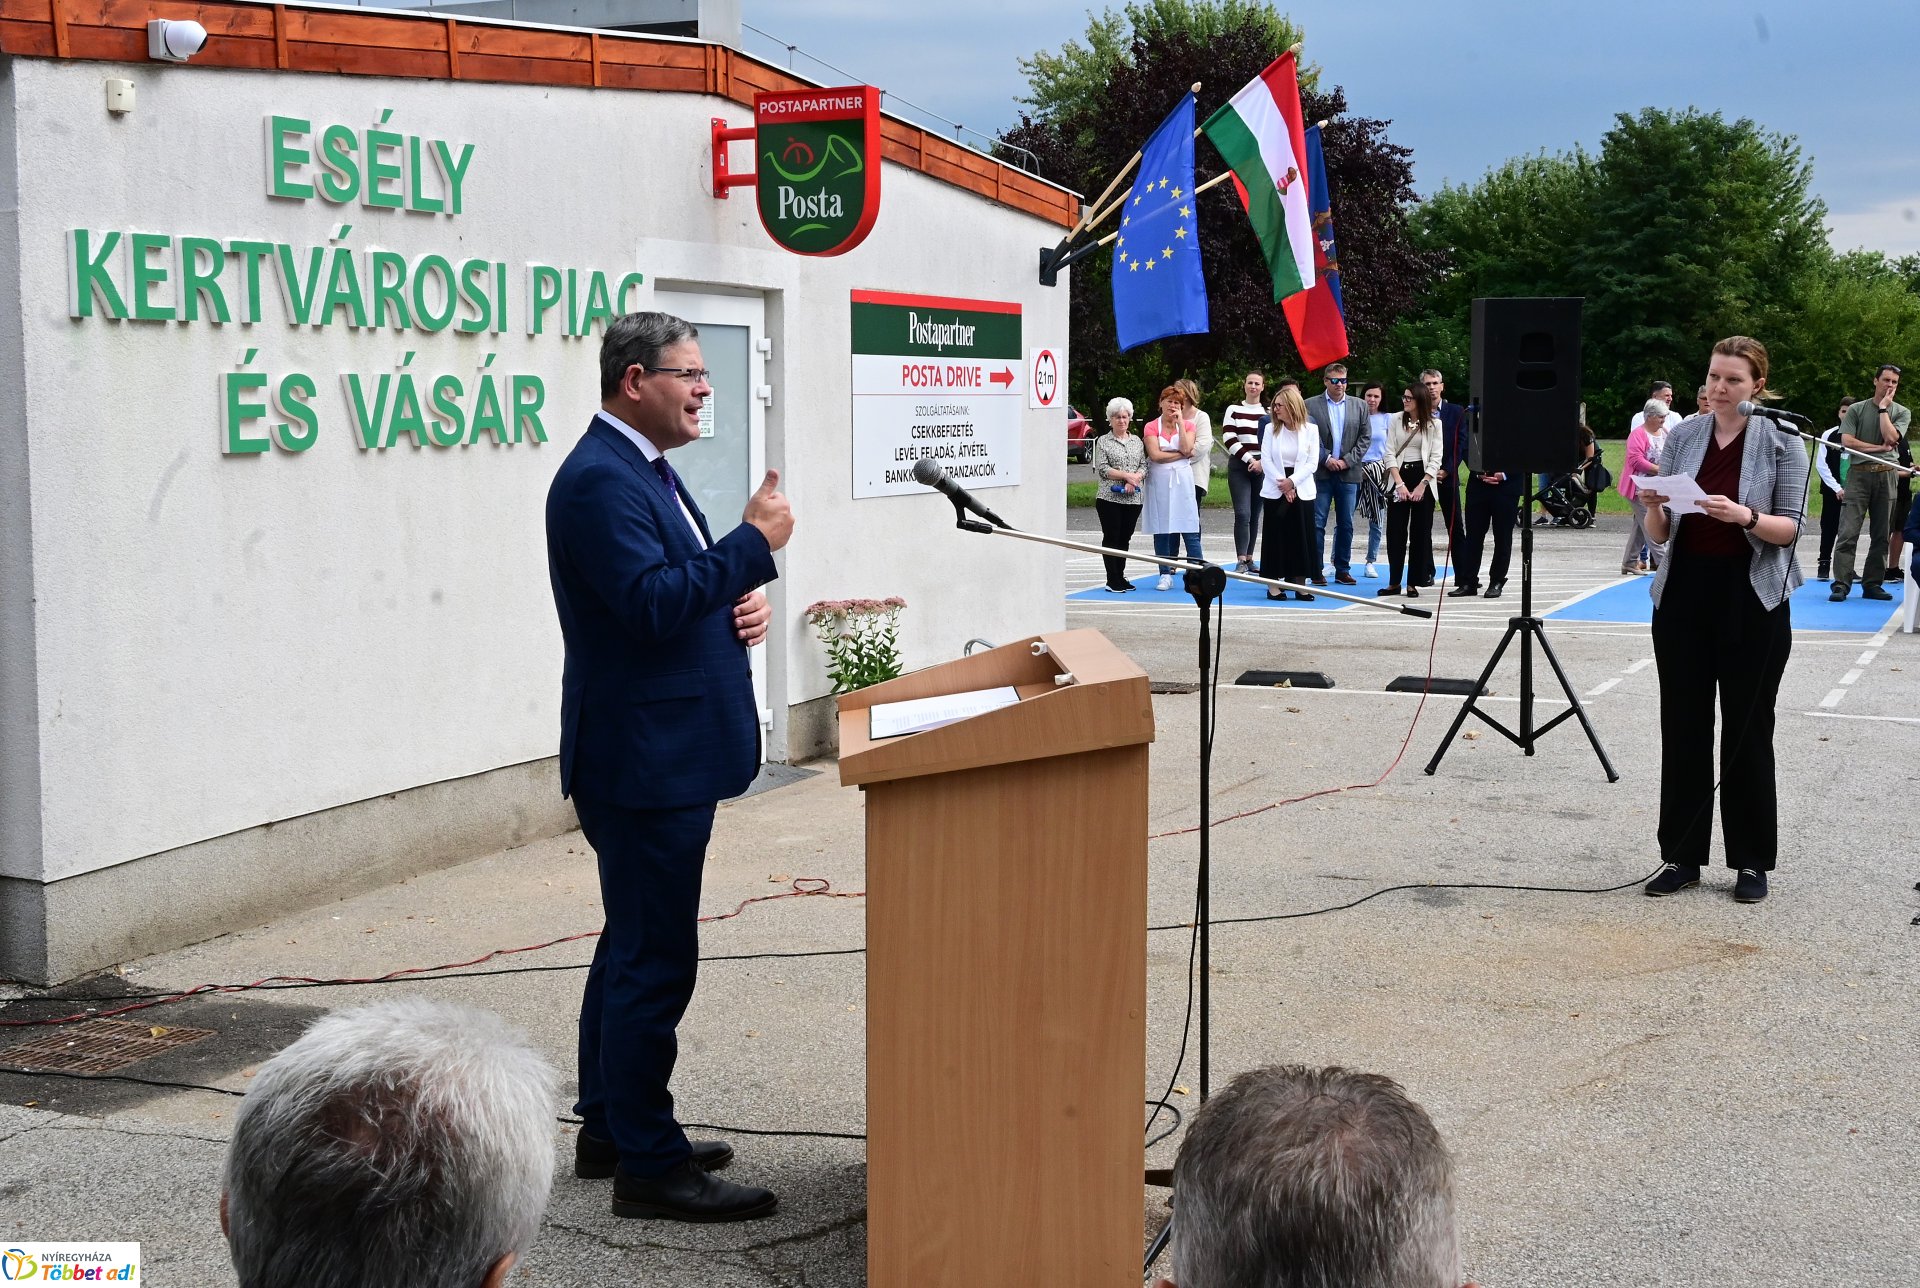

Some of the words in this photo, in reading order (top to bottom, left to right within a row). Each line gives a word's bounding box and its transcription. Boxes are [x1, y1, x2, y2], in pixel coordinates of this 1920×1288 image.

[760, 96, 863, 114] POSTAPARTNER
[264, 108, 475, 215] ESÉLY
[777, 185, 844, 219] Posta
[66, 224, 507, 333] KERTVÁROSI
[909, 311, 976, 351] Postapartner
[902, 364, 943, 387] POSTA
[946, 366, 982, 387] DRIVE
[219, 348, 320, 454] ÉS
[340, 351, 549, 450] VÁSÁR
[915, 403, 970, 417] SZOLGÁLTATÁSAINK:
[911, 421, 974, 439] CSEKKBEFIZETÉS
[894, 443, 919, 461] LEVÉL
[920, 442, 956, 460] FELADÁS,
[958, 441, 988, 458] ÁTVÉTEL
